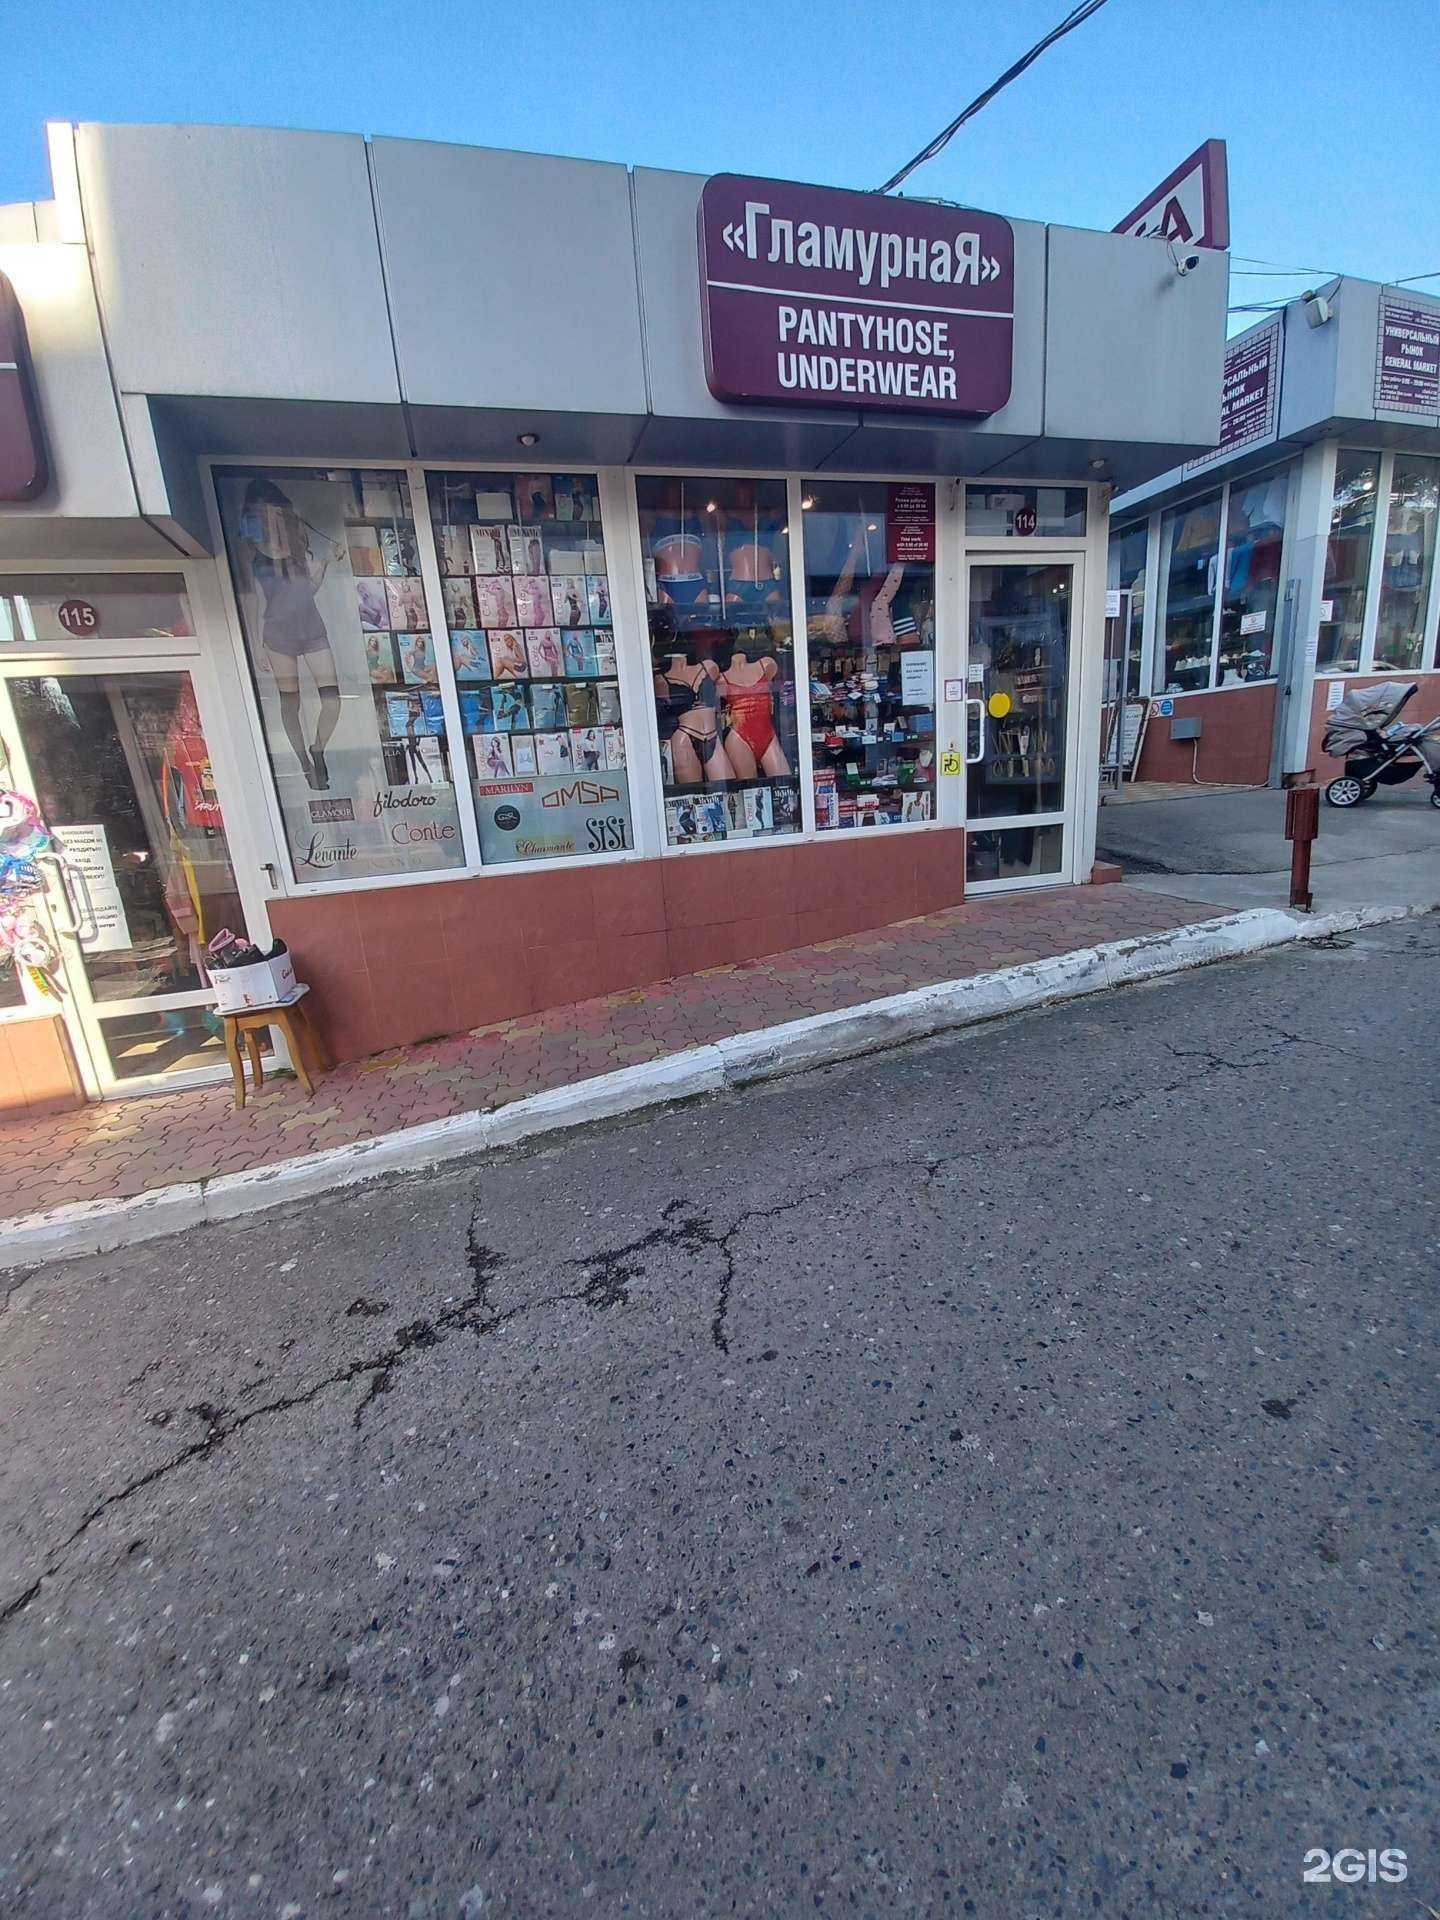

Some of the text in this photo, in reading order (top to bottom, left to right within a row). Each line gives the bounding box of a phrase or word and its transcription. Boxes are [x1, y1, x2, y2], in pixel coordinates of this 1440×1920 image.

[722, 201, 1001, 288] «ГламурнаЯ»
[778, 306, 955, 361] PANTYHOSE,
[777, 352, 958, 400] UNDERWEAR
[1384, 355, 1438, 374] GENERAL MARKET
[1232, 387, 1265, 411] MARKET
[1016, 513, 1036, 530] 114
[60, 607, 96, 626] 115
[485, 783, 530, 795] MARILYN
[541, 780, 620, 808] OMSA
[373, 790, 437, 818] filodoro
[392, 821, 456, 845] Conte
[295, 830, 359, 869] Levante
